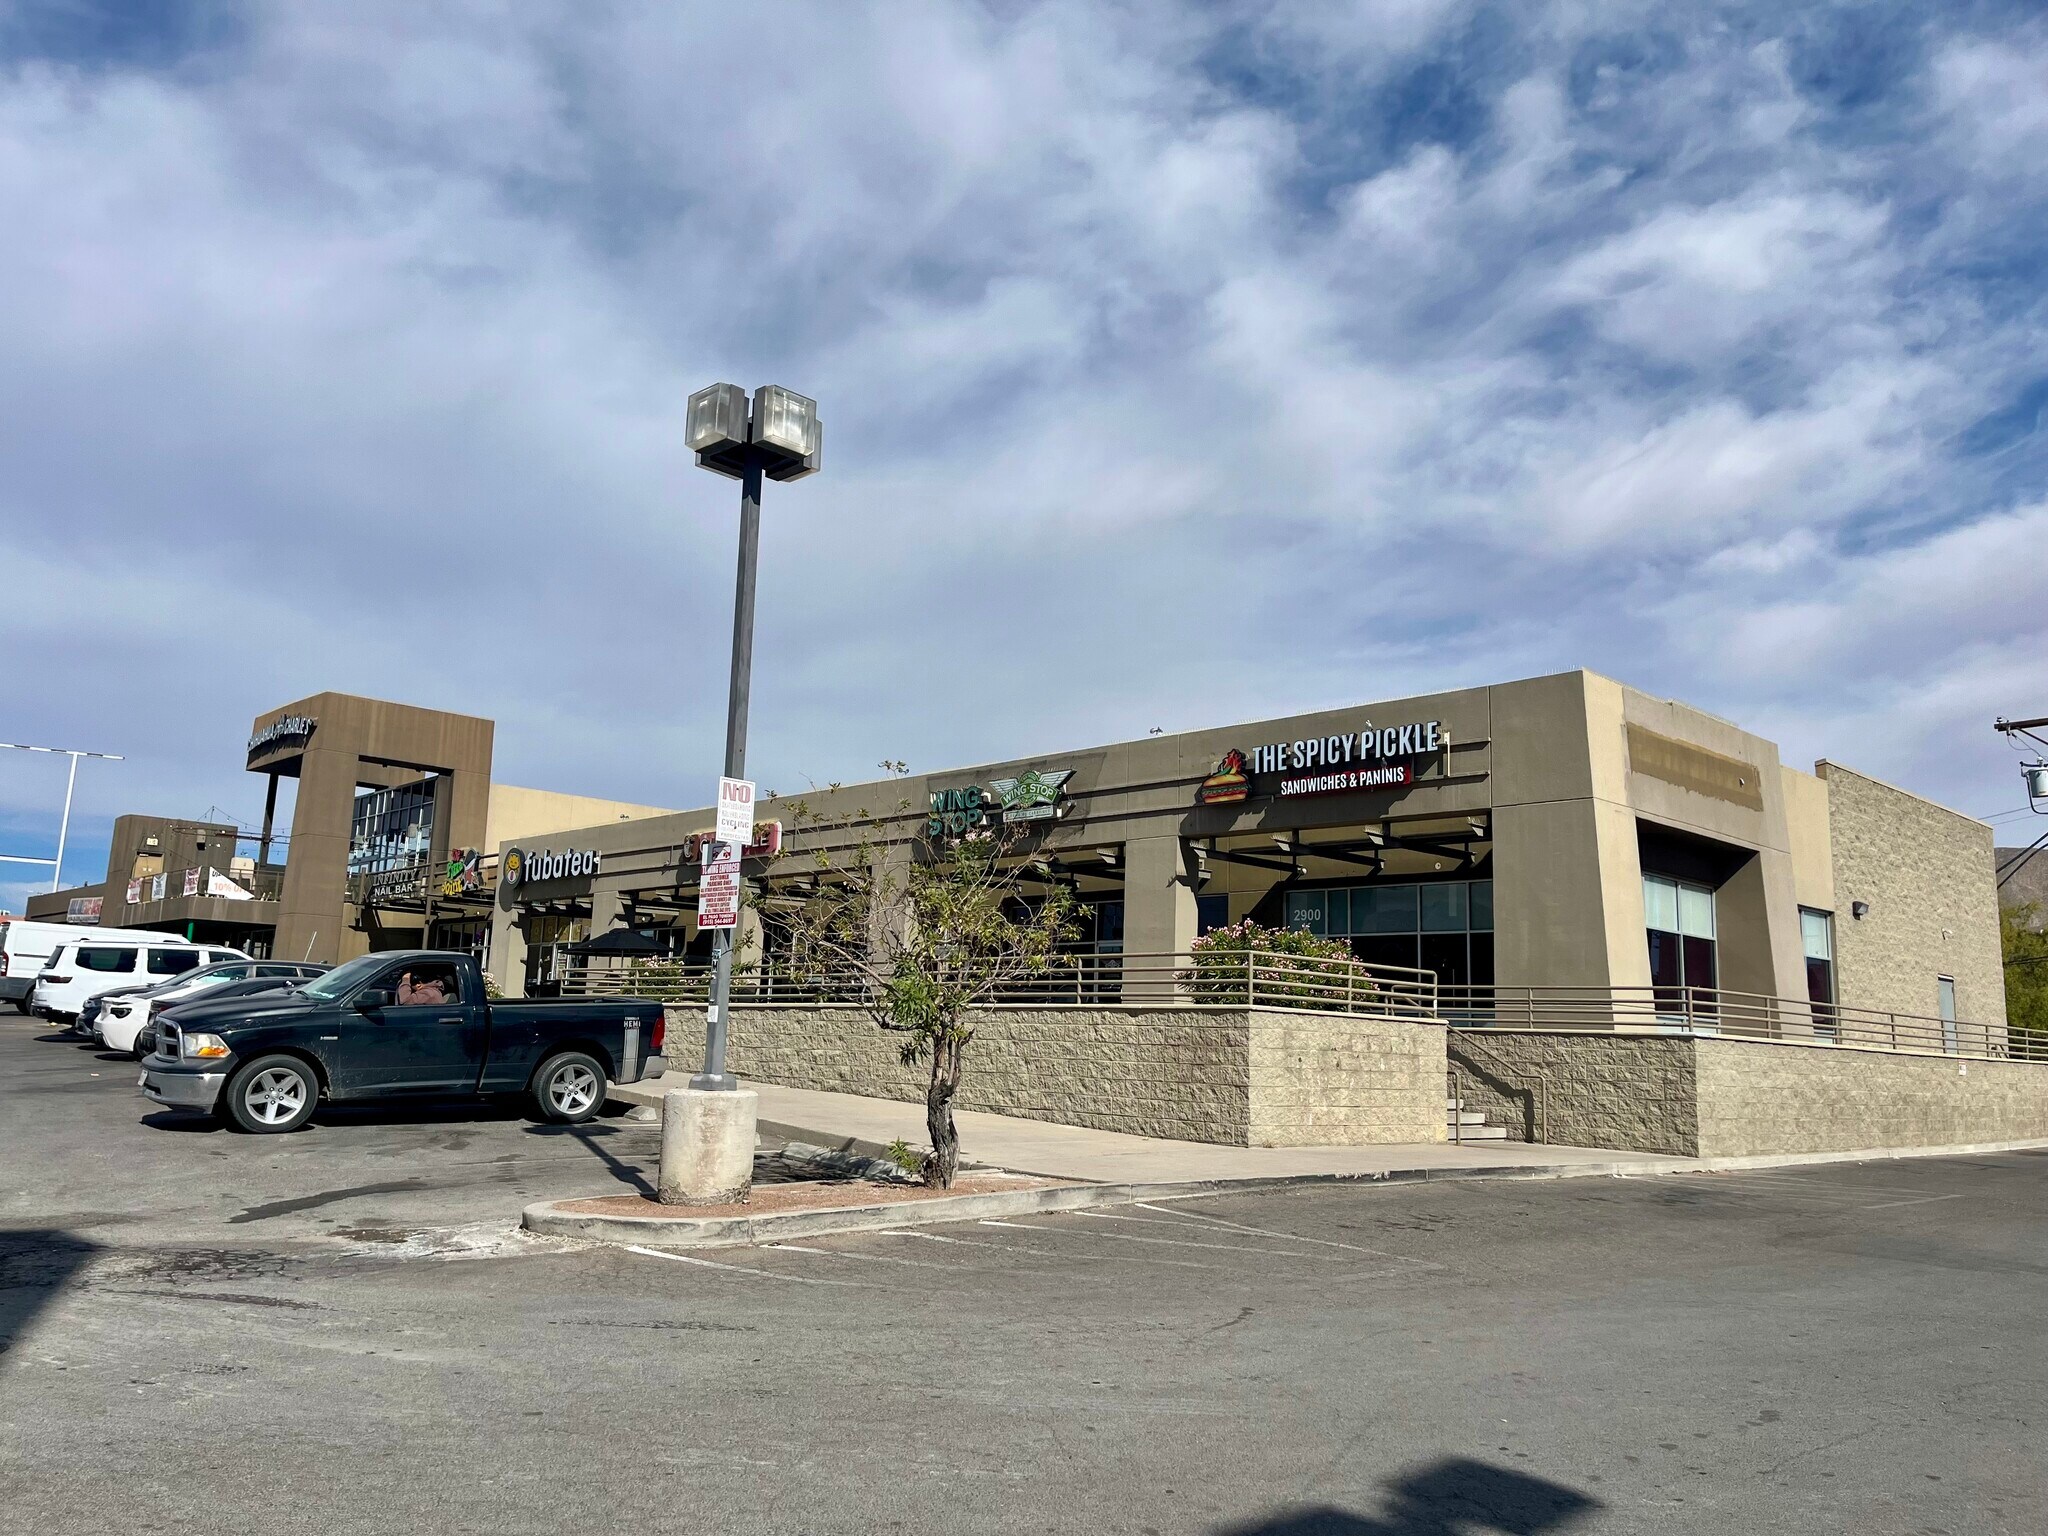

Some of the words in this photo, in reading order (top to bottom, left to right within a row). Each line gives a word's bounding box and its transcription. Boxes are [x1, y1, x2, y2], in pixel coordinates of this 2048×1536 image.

[1252, 743, 1288, 774] THE
[1293, 733, 1357, 769] SPICY
[1360, 721, 1440, 760] PICKLE
[1281, 774, 1347, 795] SANDWICHES
[1349, 773, 1357, 786] &
[1359, 767, 1404, 786] PANINIS
[722, 782, 751, 803] NO
[931, 787, 980, 812] WING
[1003, 785, 1027, 804] WING
[1030, 783, 1054, 797] STOP
[721, 818, 750, 828] CYCLING
[929, 809, 979, 836] STOP
[524, 848, 594, 881] fubatea
[214, 882, 231, 892] 10%
[373, 868, 417, 886] INFINITY
[374, 885, 393, 897] NAIL
[395, 883, 413, 894] BAR
[1293, 909, 1321, 922] 2900
[624, 1020, 641, 1028] HEMI
